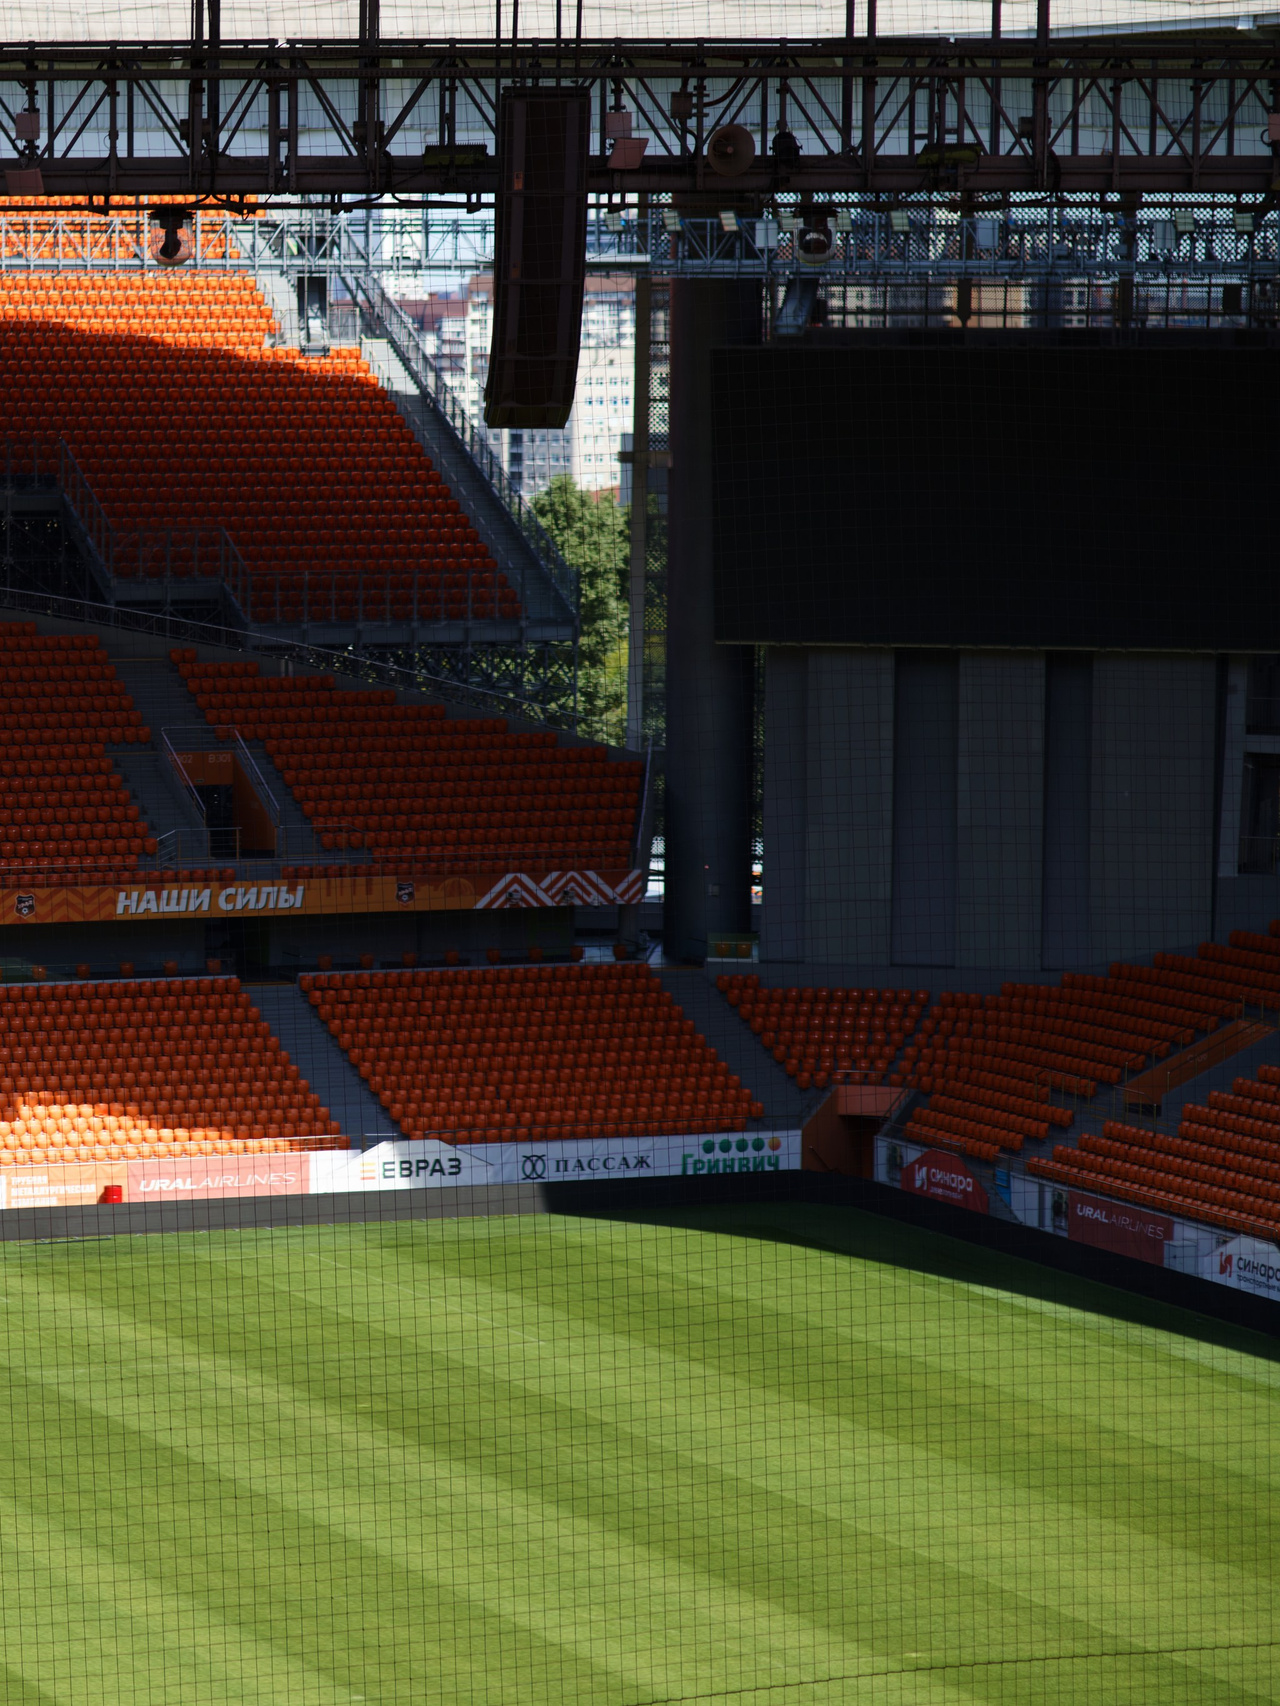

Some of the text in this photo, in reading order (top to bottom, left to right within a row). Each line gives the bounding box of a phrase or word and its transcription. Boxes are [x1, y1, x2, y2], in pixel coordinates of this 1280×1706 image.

[116, 885, 305, 914] НАШИ СИЛЫ
[382, 1157, 462, 1179] ЕВРАЗ
[555, 1155, 652, 1172] ПАССАЖ
[139, 1172, 297, 1192] URAL AIRLINES
[930, 1168, 973, 1192] синара
[1076, 1203, 1165, 1239] URAL AIRLINES
